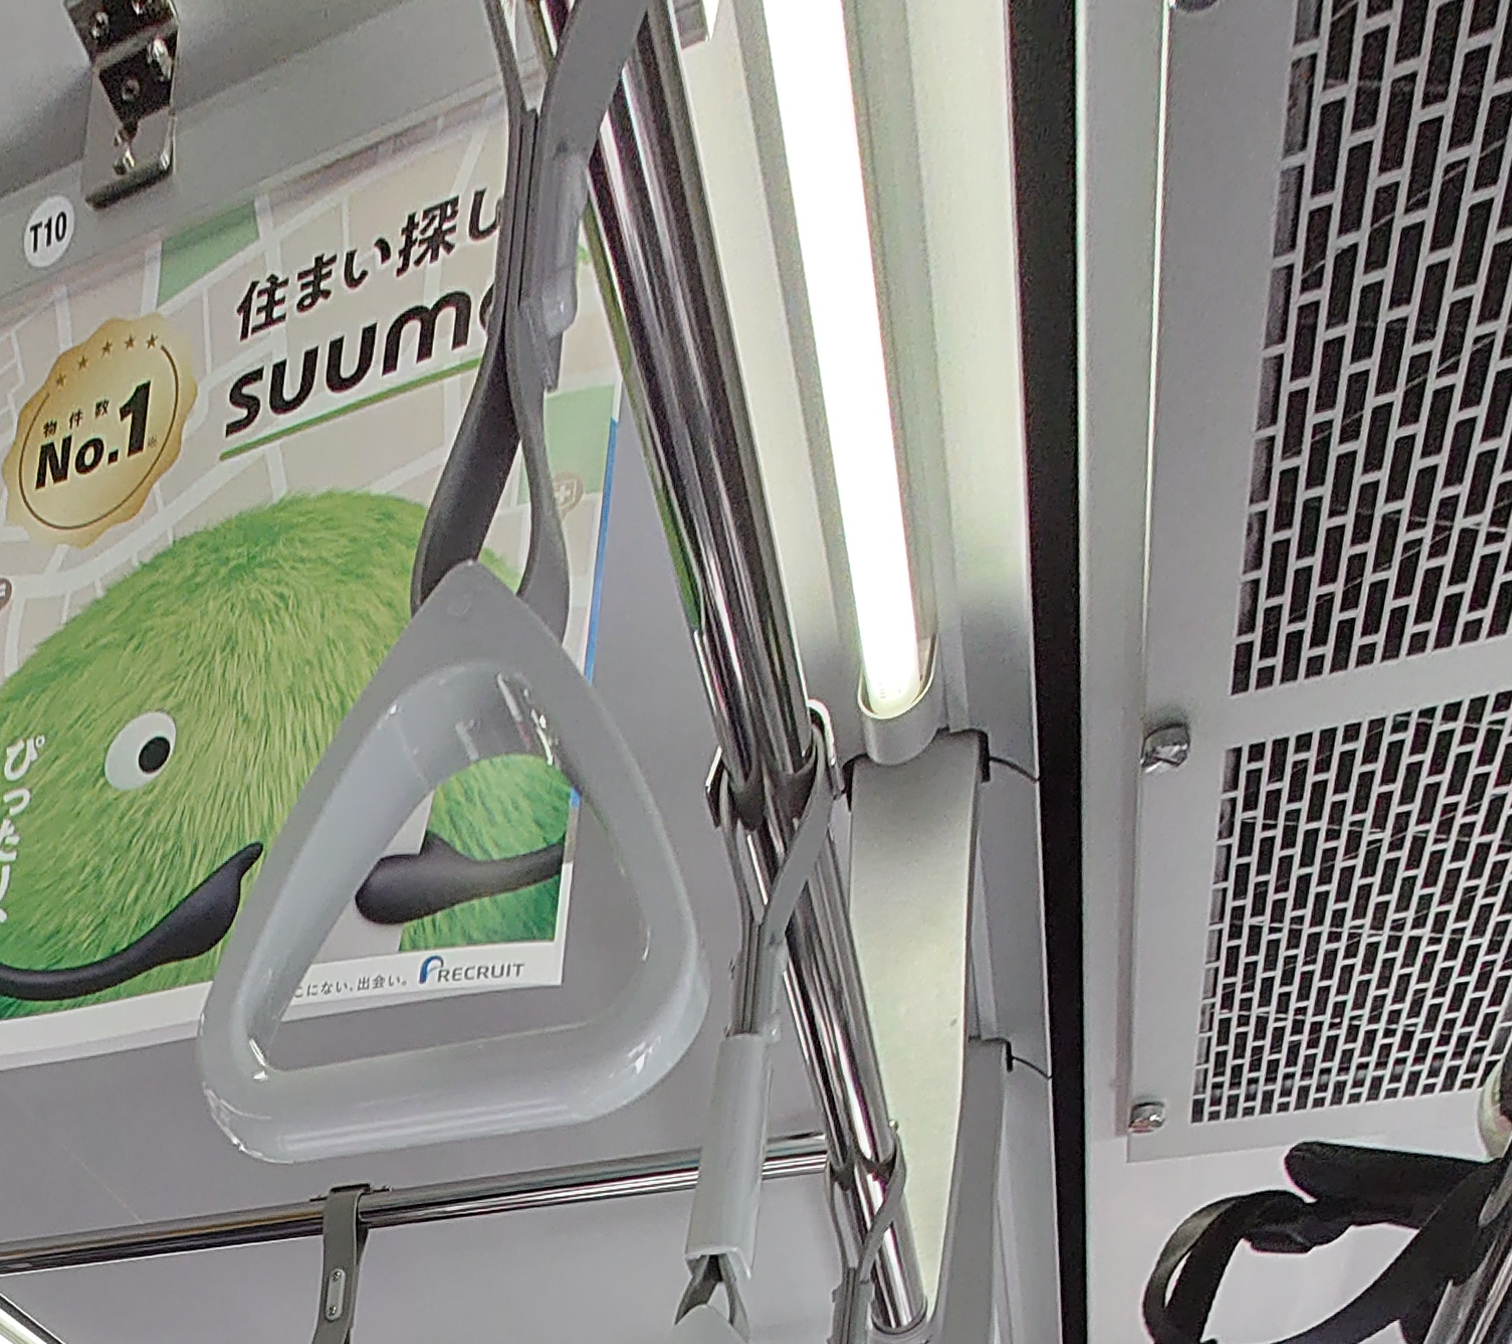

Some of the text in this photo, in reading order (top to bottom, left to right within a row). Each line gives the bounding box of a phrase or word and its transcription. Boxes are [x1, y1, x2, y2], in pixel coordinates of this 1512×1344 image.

[28, 210, 68, 255] T10
[236, 187, 501, 342] 住まい探し
[225, 284, 494, 438] SUUM
[35, 379, 152, 491] No.1
[43, 398, 110, 439] 物件数
[436, 962, 526, 983] RECRUIT
